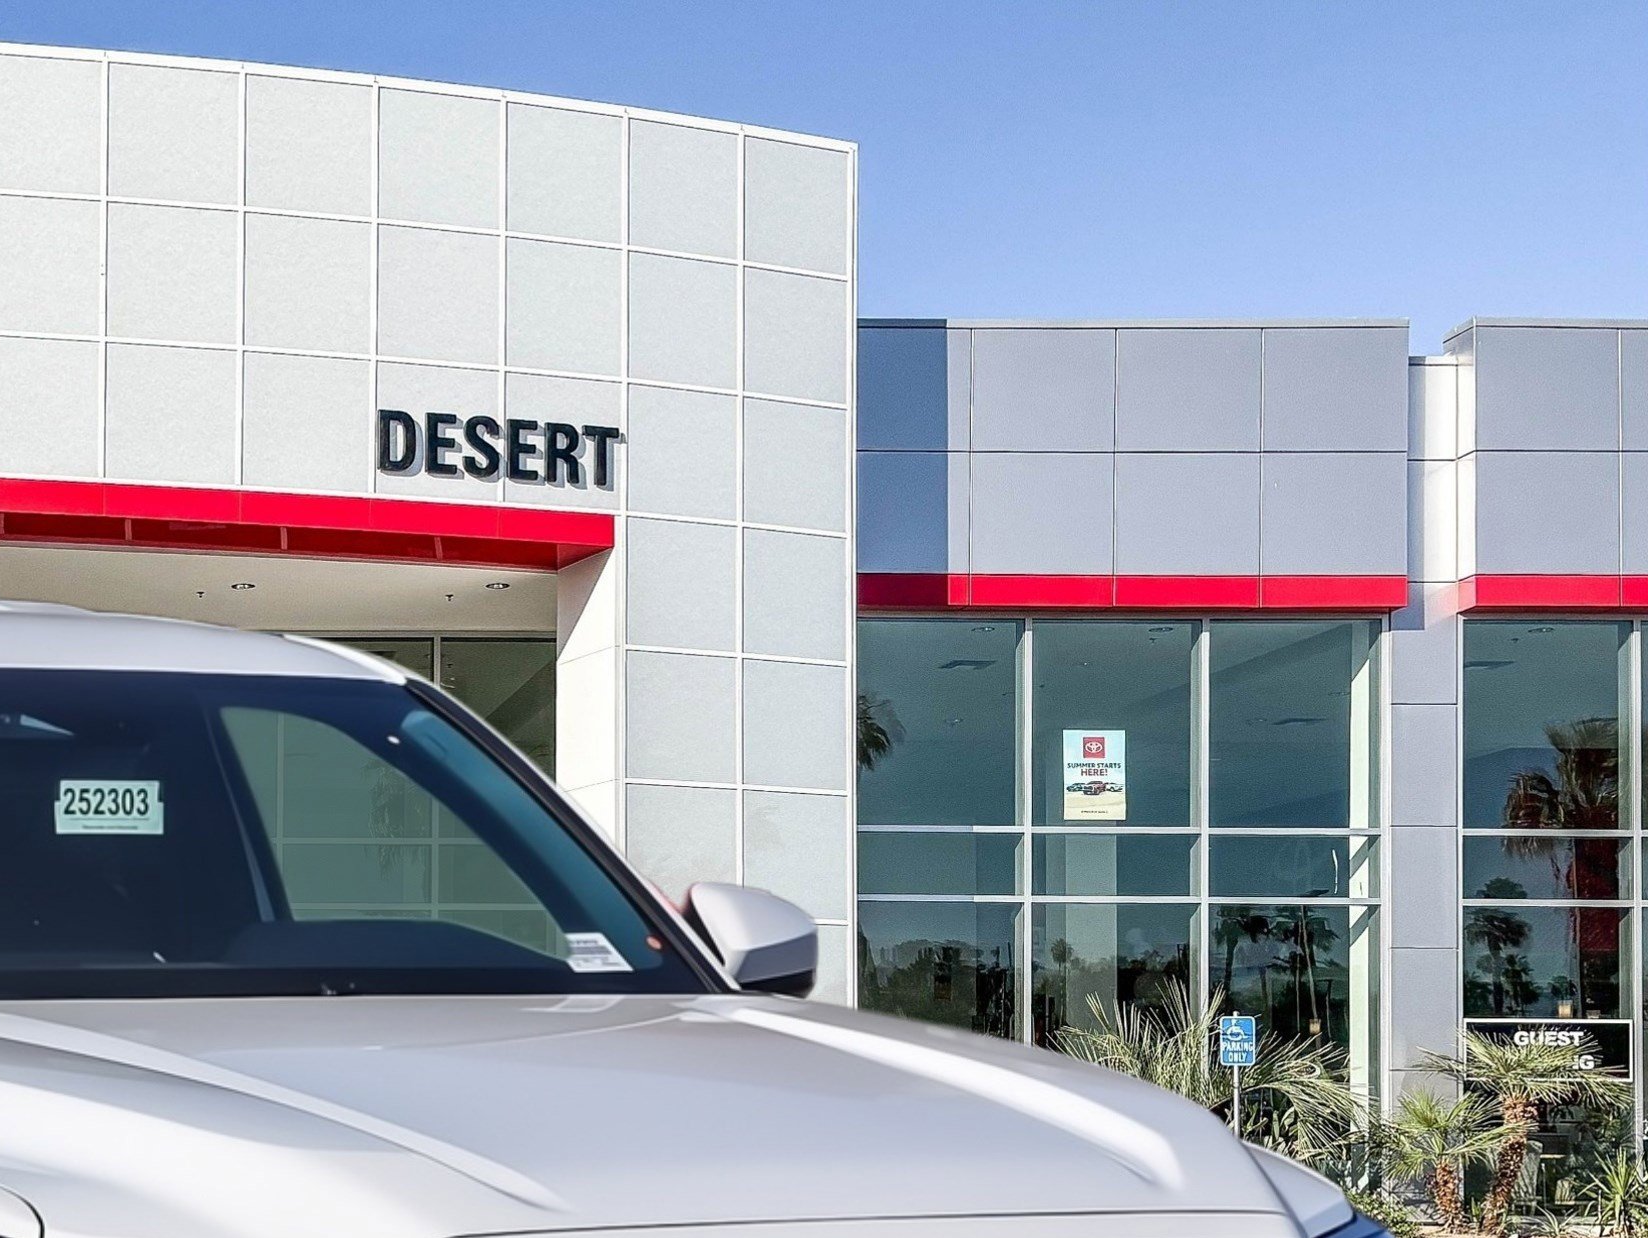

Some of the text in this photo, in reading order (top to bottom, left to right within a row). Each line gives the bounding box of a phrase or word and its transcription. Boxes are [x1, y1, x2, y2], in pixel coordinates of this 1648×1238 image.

[376, 408, 620, 486] DESERT
[1081, 768, 1108, 777] HERE!
[63, 788, 150, 816] 252303
[1513, 1030, 1584, 1046] GUEST
[1222, 1041, 1253, 1052] PARKING
[1228, 1051, 1248, 1063] ONLY
